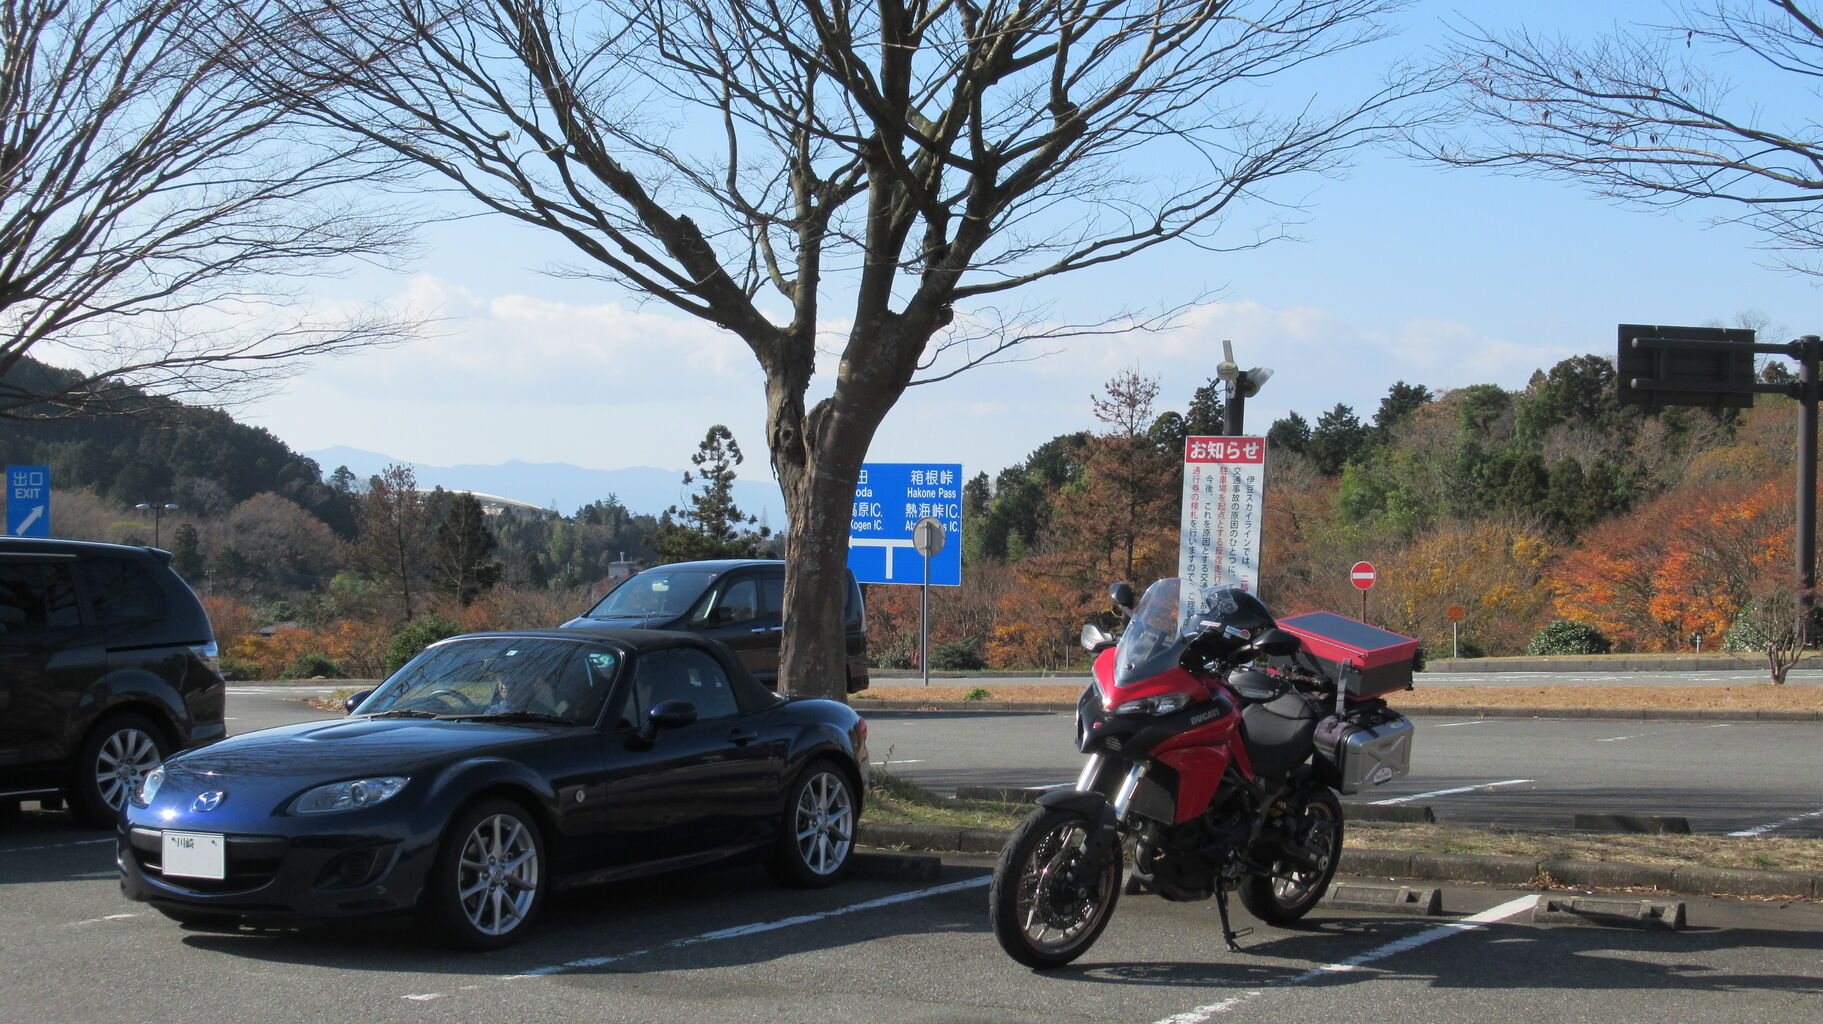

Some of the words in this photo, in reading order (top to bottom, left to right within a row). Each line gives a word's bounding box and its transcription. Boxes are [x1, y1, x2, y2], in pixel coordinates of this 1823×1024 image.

[1190, 441, 1259, 459] お知らせ
[13, 471, 43, 486] 出口
[857, 470, 868, 484] 田
[910, 470, 954, 486] 箱根峠
[15, 488, 40, 499] EXIT
[855, 487, 873, 498] oda
[907, 487, 936, 498] Hakone
[938, 487, 957, 498] Pass
[1213, 466, 1229, 586] 駐車場を起点とする反復走行
[1190, 708, 1220, 725] DUCATI
[176, 836, 194, 848] 川崎
